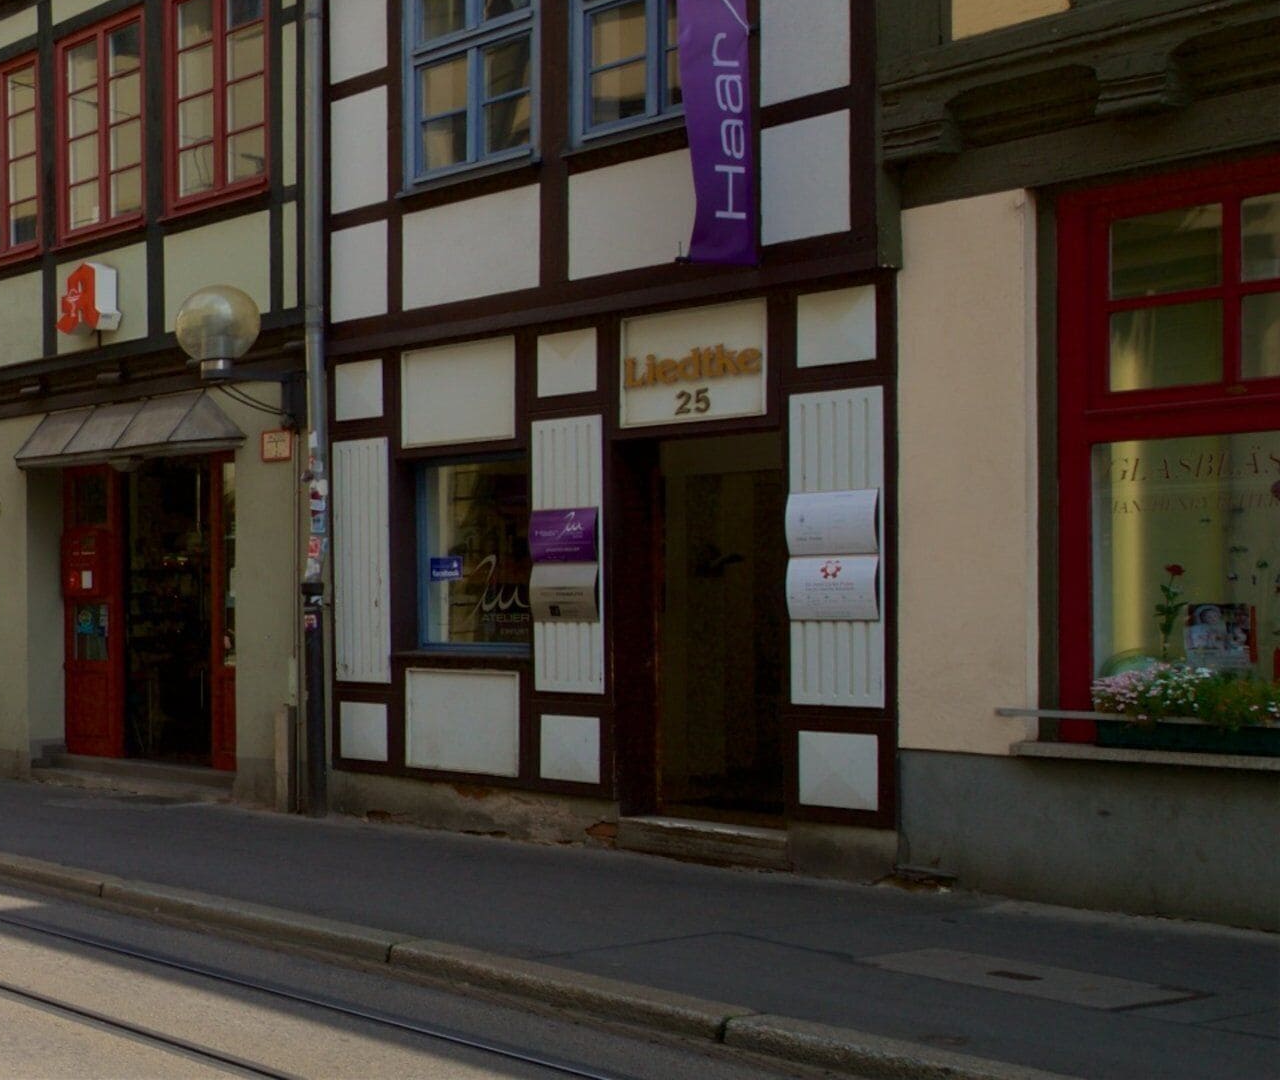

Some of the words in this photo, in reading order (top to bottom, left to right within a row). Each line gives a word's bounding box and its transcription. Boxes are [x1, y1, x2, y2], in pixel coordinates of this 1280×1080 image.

[711, 32, 747, 221] Haar
[624, 343, 762, 388] Liedtke
[675, 387, 710, 415] 25
[482, 613, 530, 623] ATELIER
